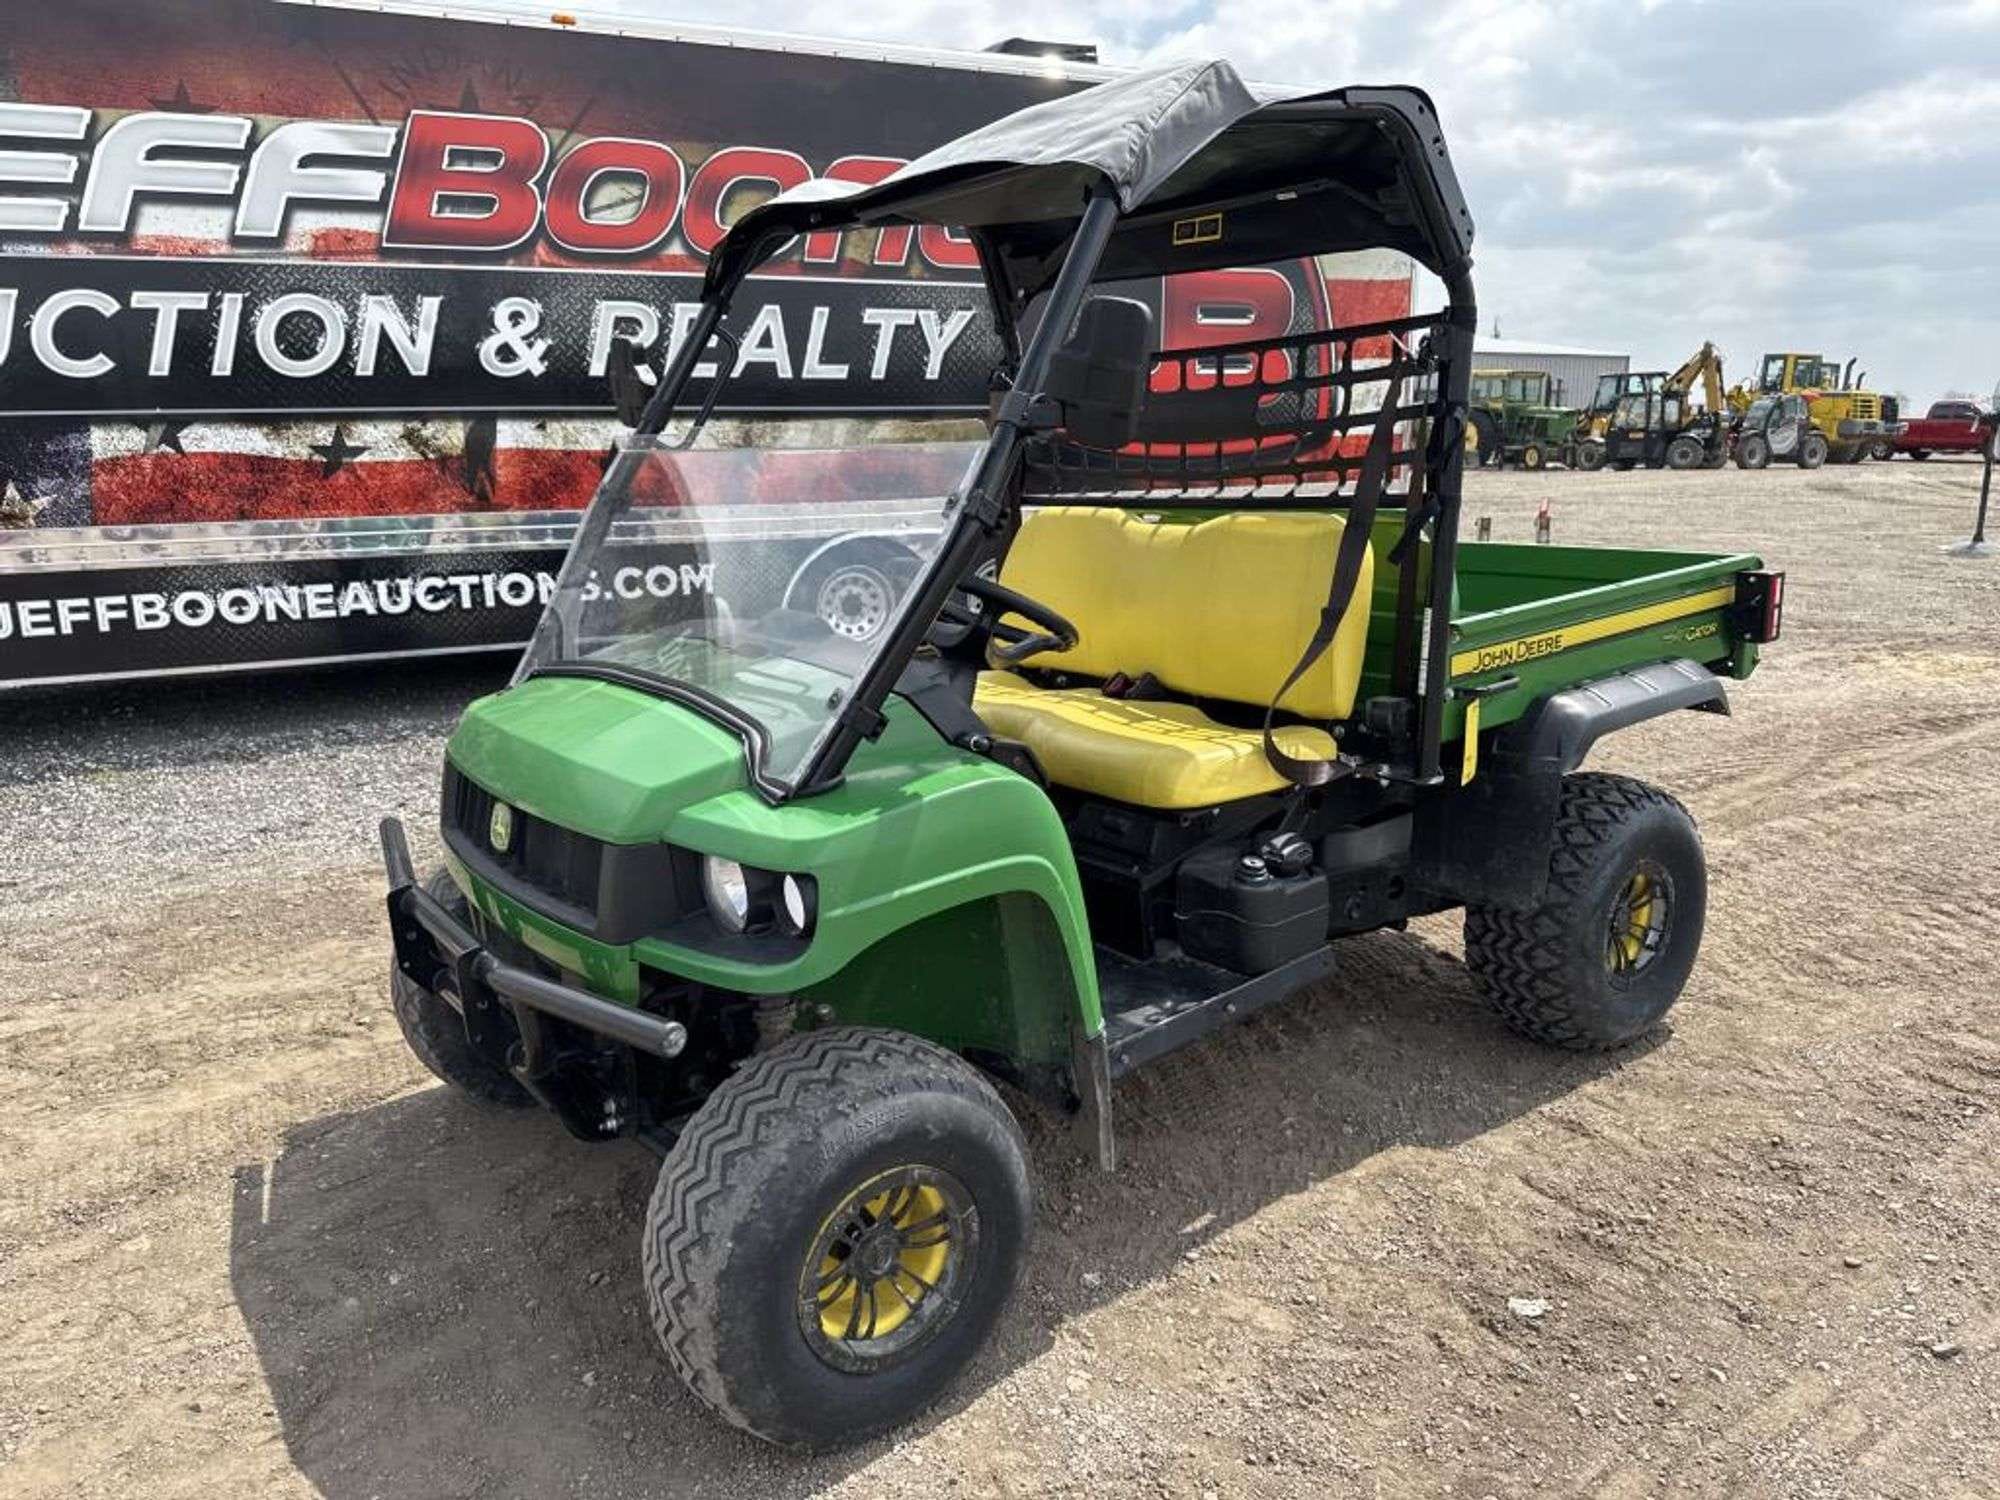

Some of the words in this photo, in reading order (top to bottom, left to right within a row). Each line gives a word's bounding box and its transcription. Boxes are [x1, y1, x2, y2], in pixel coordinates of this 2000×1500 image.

[0, 288, 443, 378] CTION
[477, 296, 549, 379] &
[588, 299, 977, 386] REALTY
[1473, 646, 1514, 672] JOHN
[1516, 634, 1563, 661] DEERE
